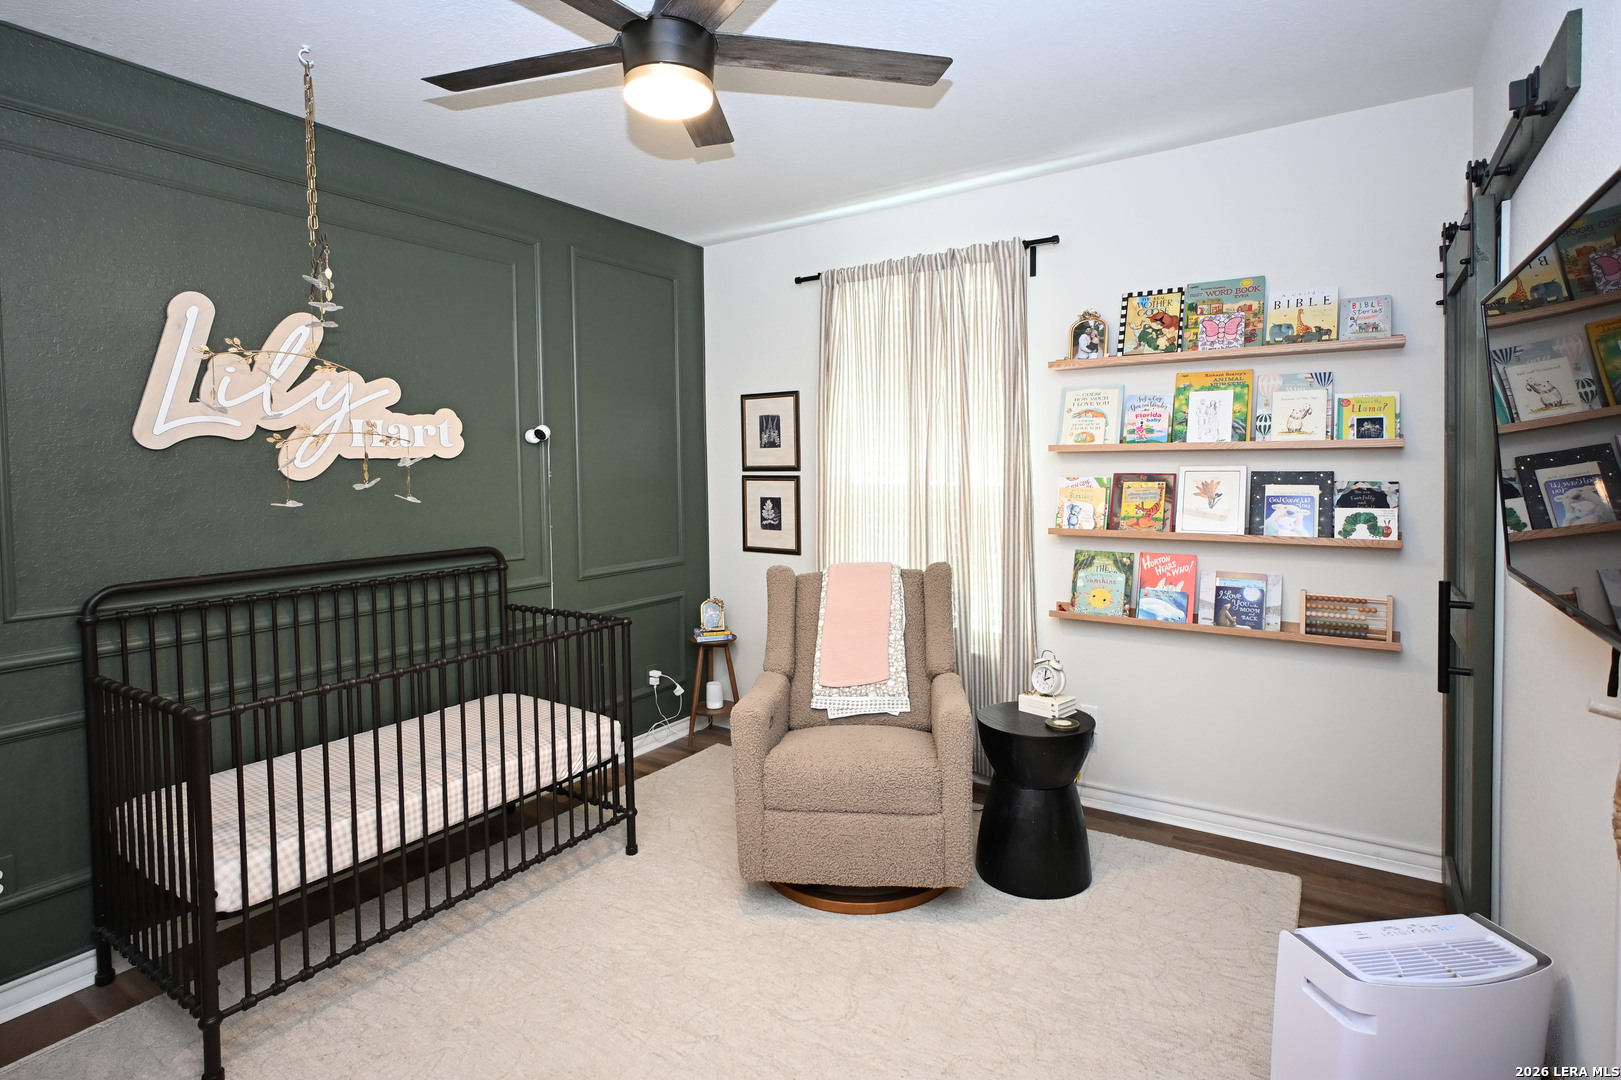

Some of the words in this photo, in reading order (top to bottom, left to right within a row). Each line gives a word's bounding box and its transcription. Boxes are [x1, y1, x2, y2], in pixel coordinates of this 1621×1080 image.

[1236, 285, 1261, 294] BOOK
[1137, 299, 1172, 308] MOTHER
[1274, 296, 1332, 310] BIBLE
[1352, 300, 1382, 309] BIBLE
[152, 305, 390, 469] Lily
[1352, 403, 1388, 412] Llama?
[350, 418, 454, 448] Hart
[1142, 555, 1170, 570] HORTON
[1155, 561, 1176, 575] HEARS
[1171, 560, 1194, 576] WHO!
[1085, 575, 1117, 584] Sunshine
[1217, 590, 1223, 598] I
